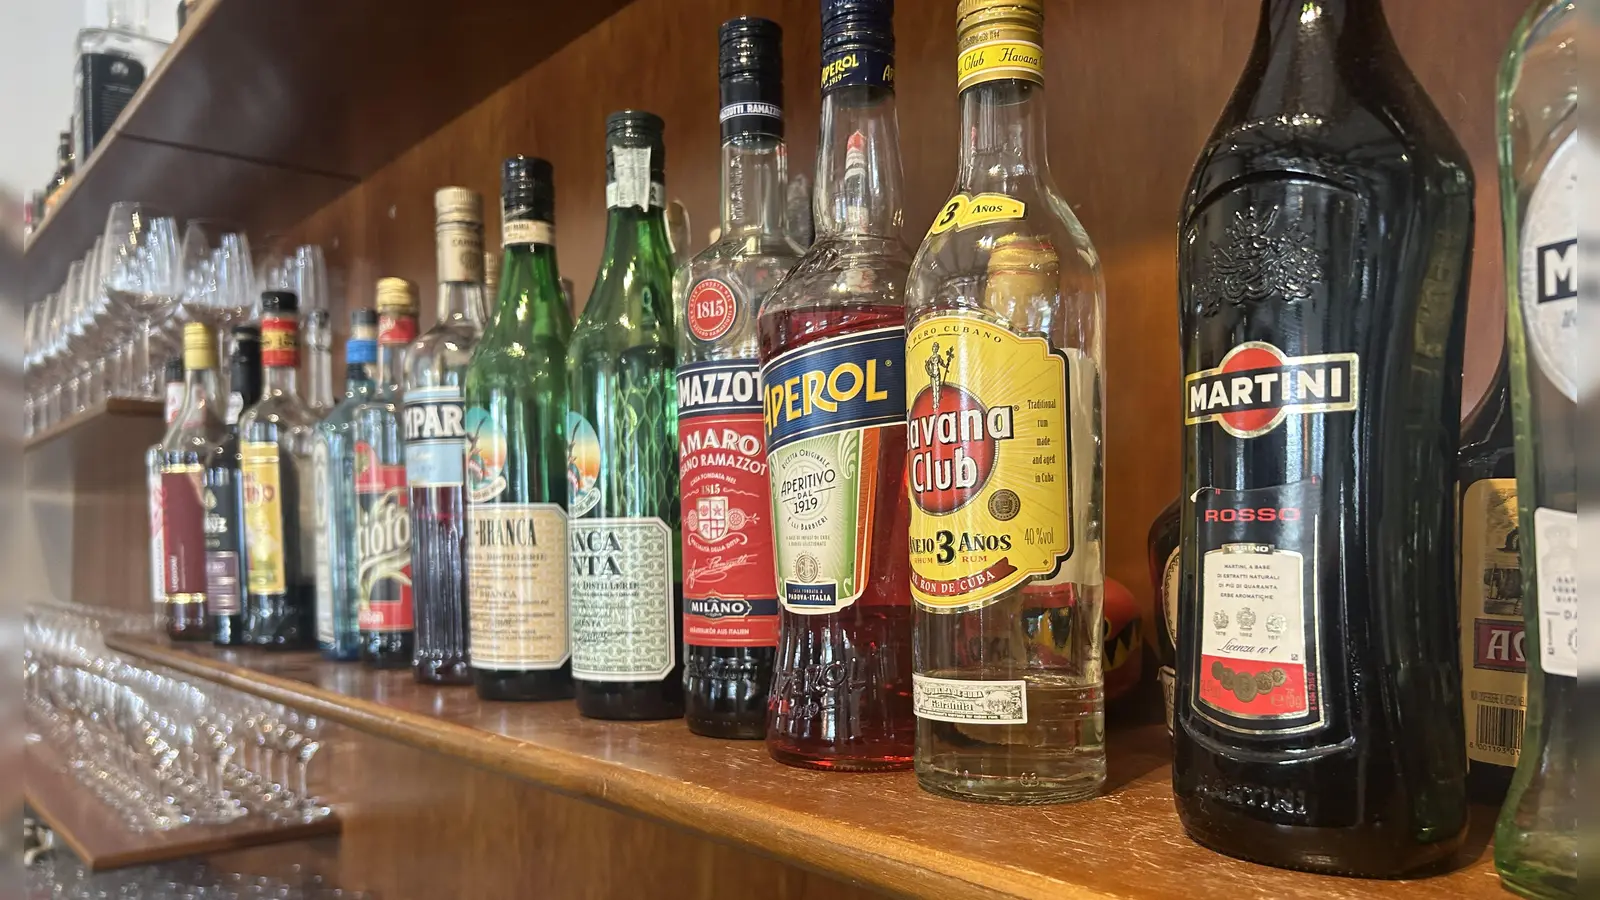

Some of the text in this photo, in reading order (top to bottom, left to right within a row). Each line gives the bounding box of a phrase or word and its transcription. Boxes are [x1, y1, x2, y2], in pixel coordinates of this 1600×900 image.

[964, 51, 985, 71] Club
[999, 47, 1038, 66] Havana
[829, 73, 843, 87] 1919
[939, 201, 1003, 227] 3 AÑOS
[696, 299, 725, 319] 1815
[912, 325, 1002, 345] PURO CUBANO
[675, 370, 764, 408] MAZZOT
[763, 358, 888, 437] APEROL
[1190, 367, 1342, 413] MARTINI
[1027, 398, 1056, 410] Traditional
[906, 405, 1015, 452] avana
[1037, 419, 1049, 428] rum
[681, 428, 761, 458] AMARO
[1036, 435, 1051, 447] made
[782, 448, 830, 470] RICETTA ORIGINALE
[1032, 453, 1056, 466] and aged
[912, 446, 978, 493] Club
[1035, 471, 1055, 483] in Cuba
[701, 483, 721, 495] 1815
[781, 468, 836, 497] APERITIVO
[797, 489, 813, 500] DAL
[794, 497, 818, 514] 1919
[800, 515, 828, 531] BARBIERI
[1204, 507, 1301, 523] ROSSO
[1024, 527, 1054, 545] 40 %vol
[936, 529, 956, 565] 3
[957, 532, 1012, 552] AÑOS
[962, 555, 988, 563] RUM
[920, 579, 937, 592] RON
[941, 582, 956, 593] DE
[960, 571, 996, 591] CUBA
[788, 593, 832, 602] PADOVA-ITALIA
[691, 601, 745, 613] MILANO
[1216, 637, 1256, 654] Licenza
